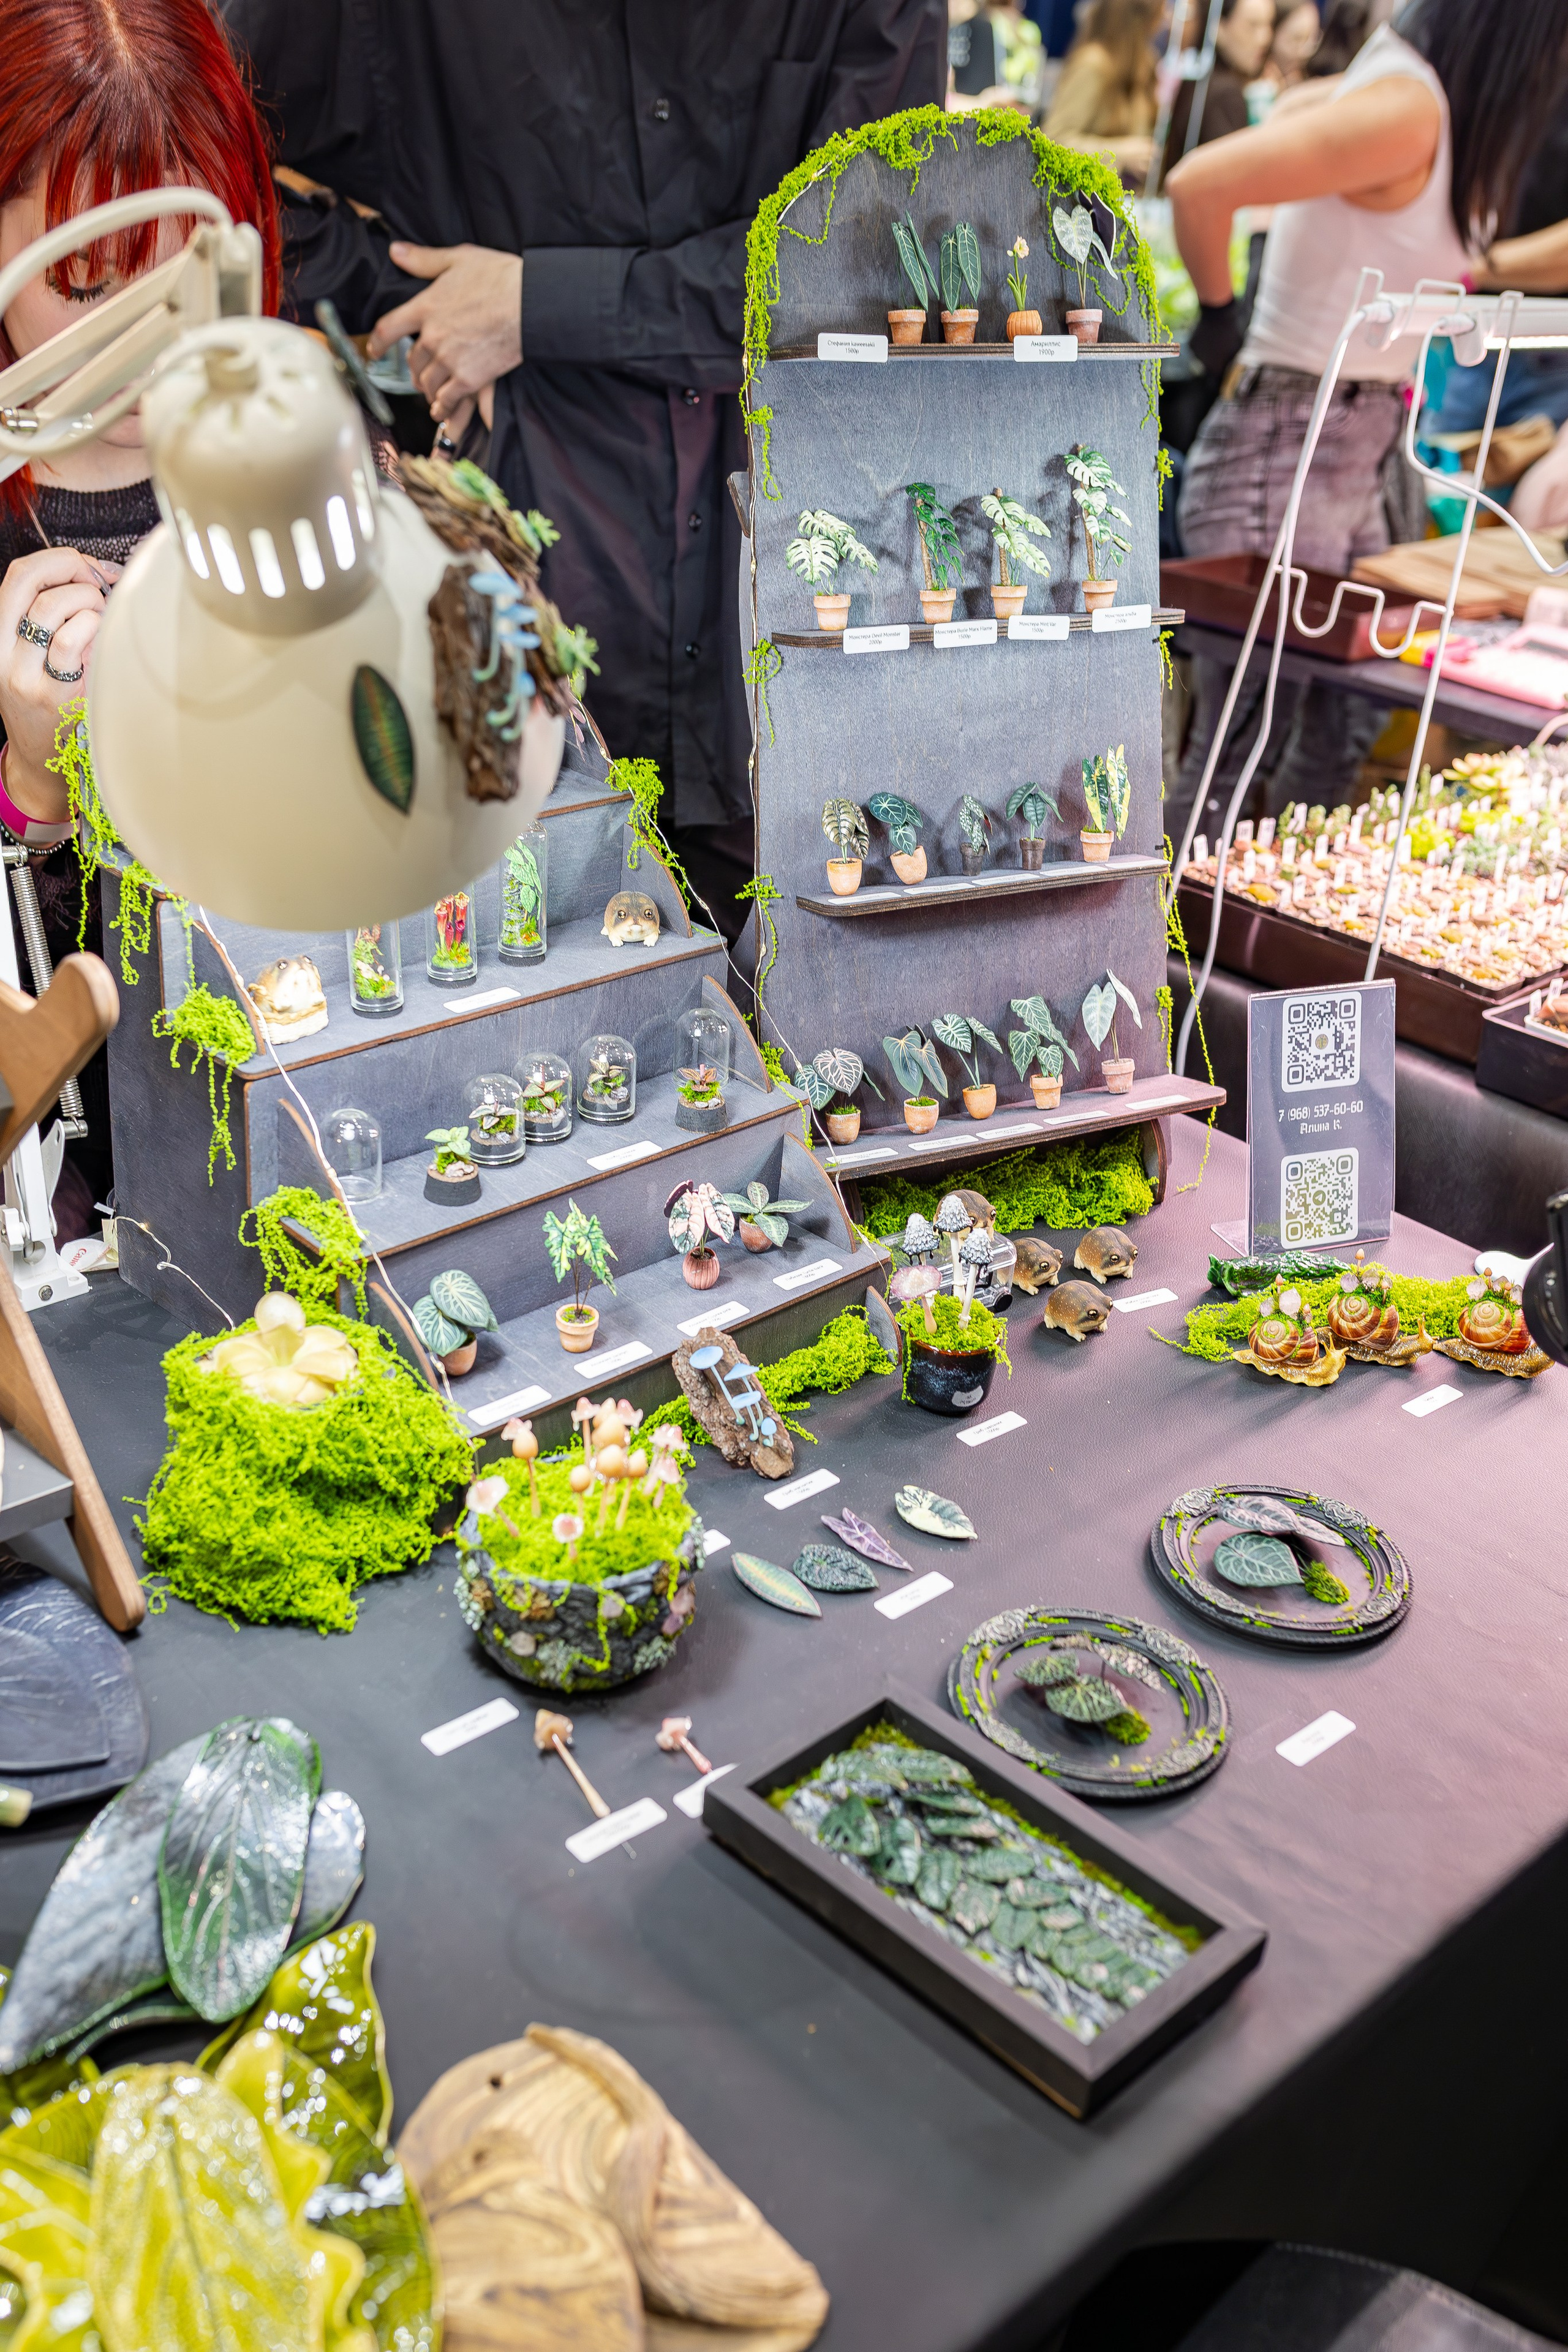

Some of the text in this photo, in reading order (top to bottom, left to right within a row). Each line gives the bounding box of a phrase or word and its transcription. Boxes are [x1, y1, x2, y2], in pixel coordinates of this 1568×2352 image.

[1278, 1100, 1363, 1122] 7 (968) 537-60-60
[69, 1248, 87, 1266] Cano
